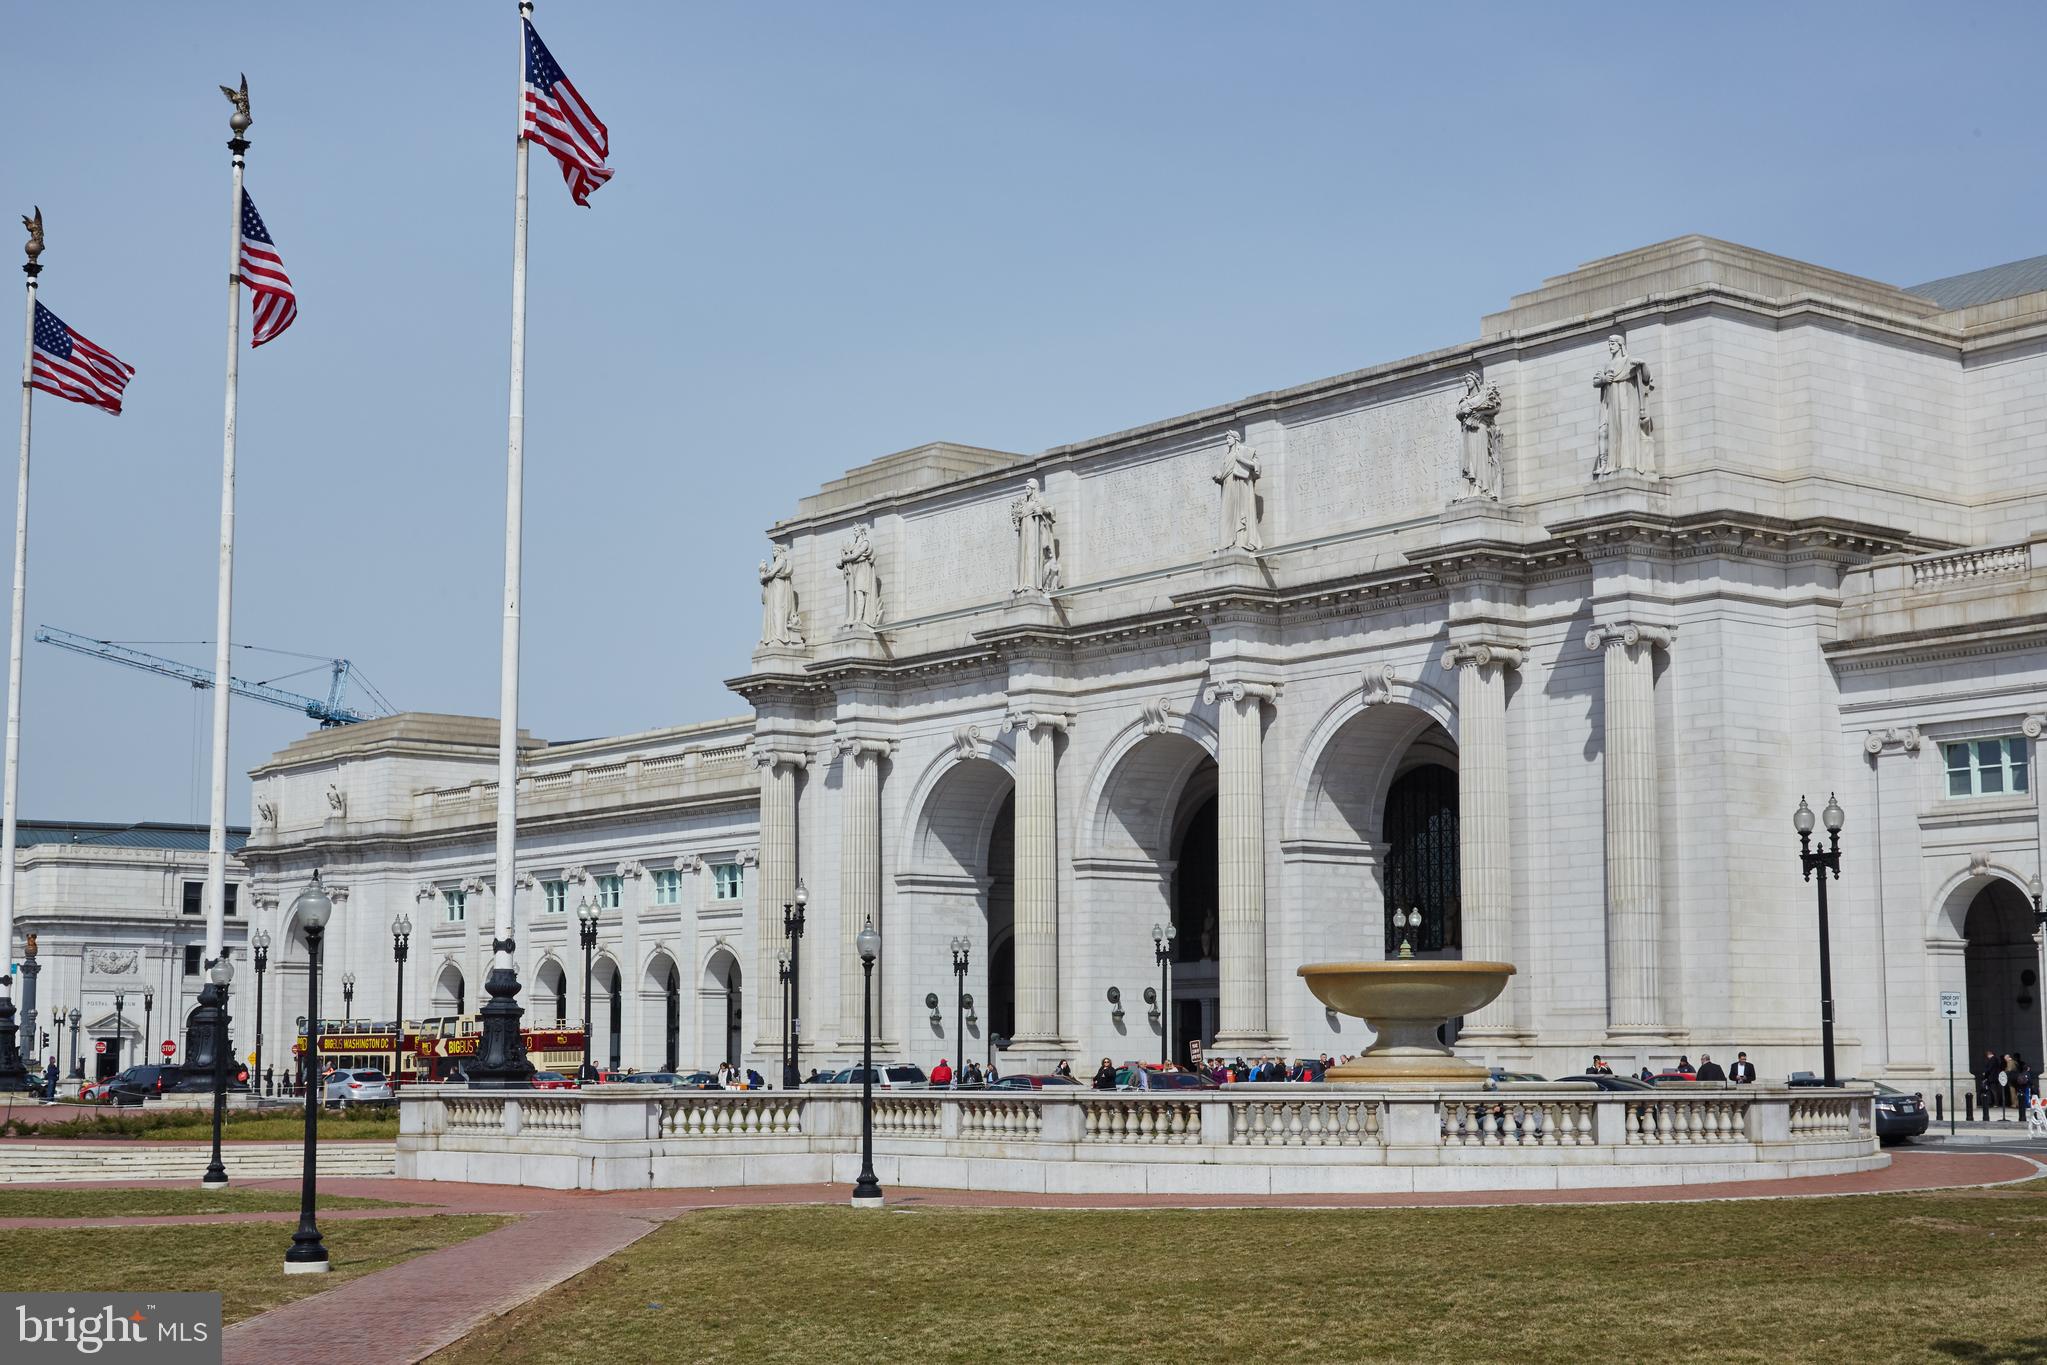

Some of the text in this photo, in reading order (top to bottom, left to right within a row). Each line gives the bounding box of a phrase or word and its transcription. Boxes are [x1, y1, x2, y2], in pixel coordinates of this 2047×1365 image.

[161, 1044, 176, 1052] STOP
[343, 1038, 380, 1049] WASHINGTON
[380, 1038, 389, 1048] DC
